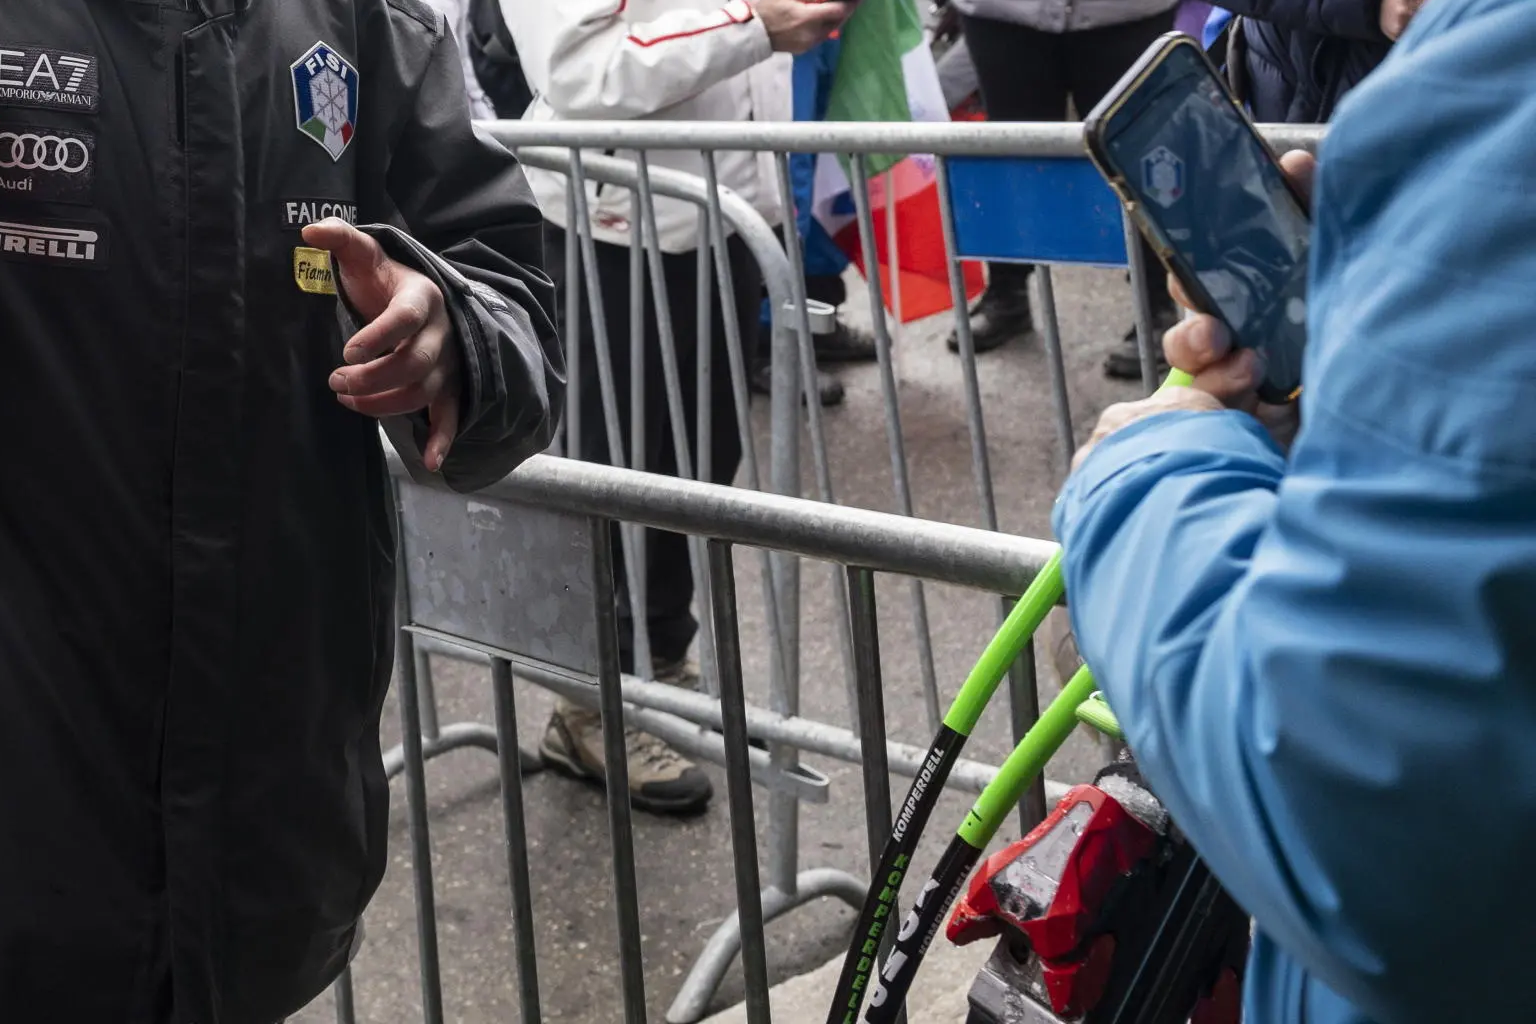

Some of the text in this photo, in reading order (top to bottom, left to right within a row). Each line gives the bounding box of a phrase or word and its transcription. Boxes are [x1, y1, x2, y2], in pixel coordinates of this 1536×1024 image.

[304, 52, 348, 80] FISI
[53, 94, 92, 106] ARMANI
[892, 746, 945, 843] KOMPERDELL
